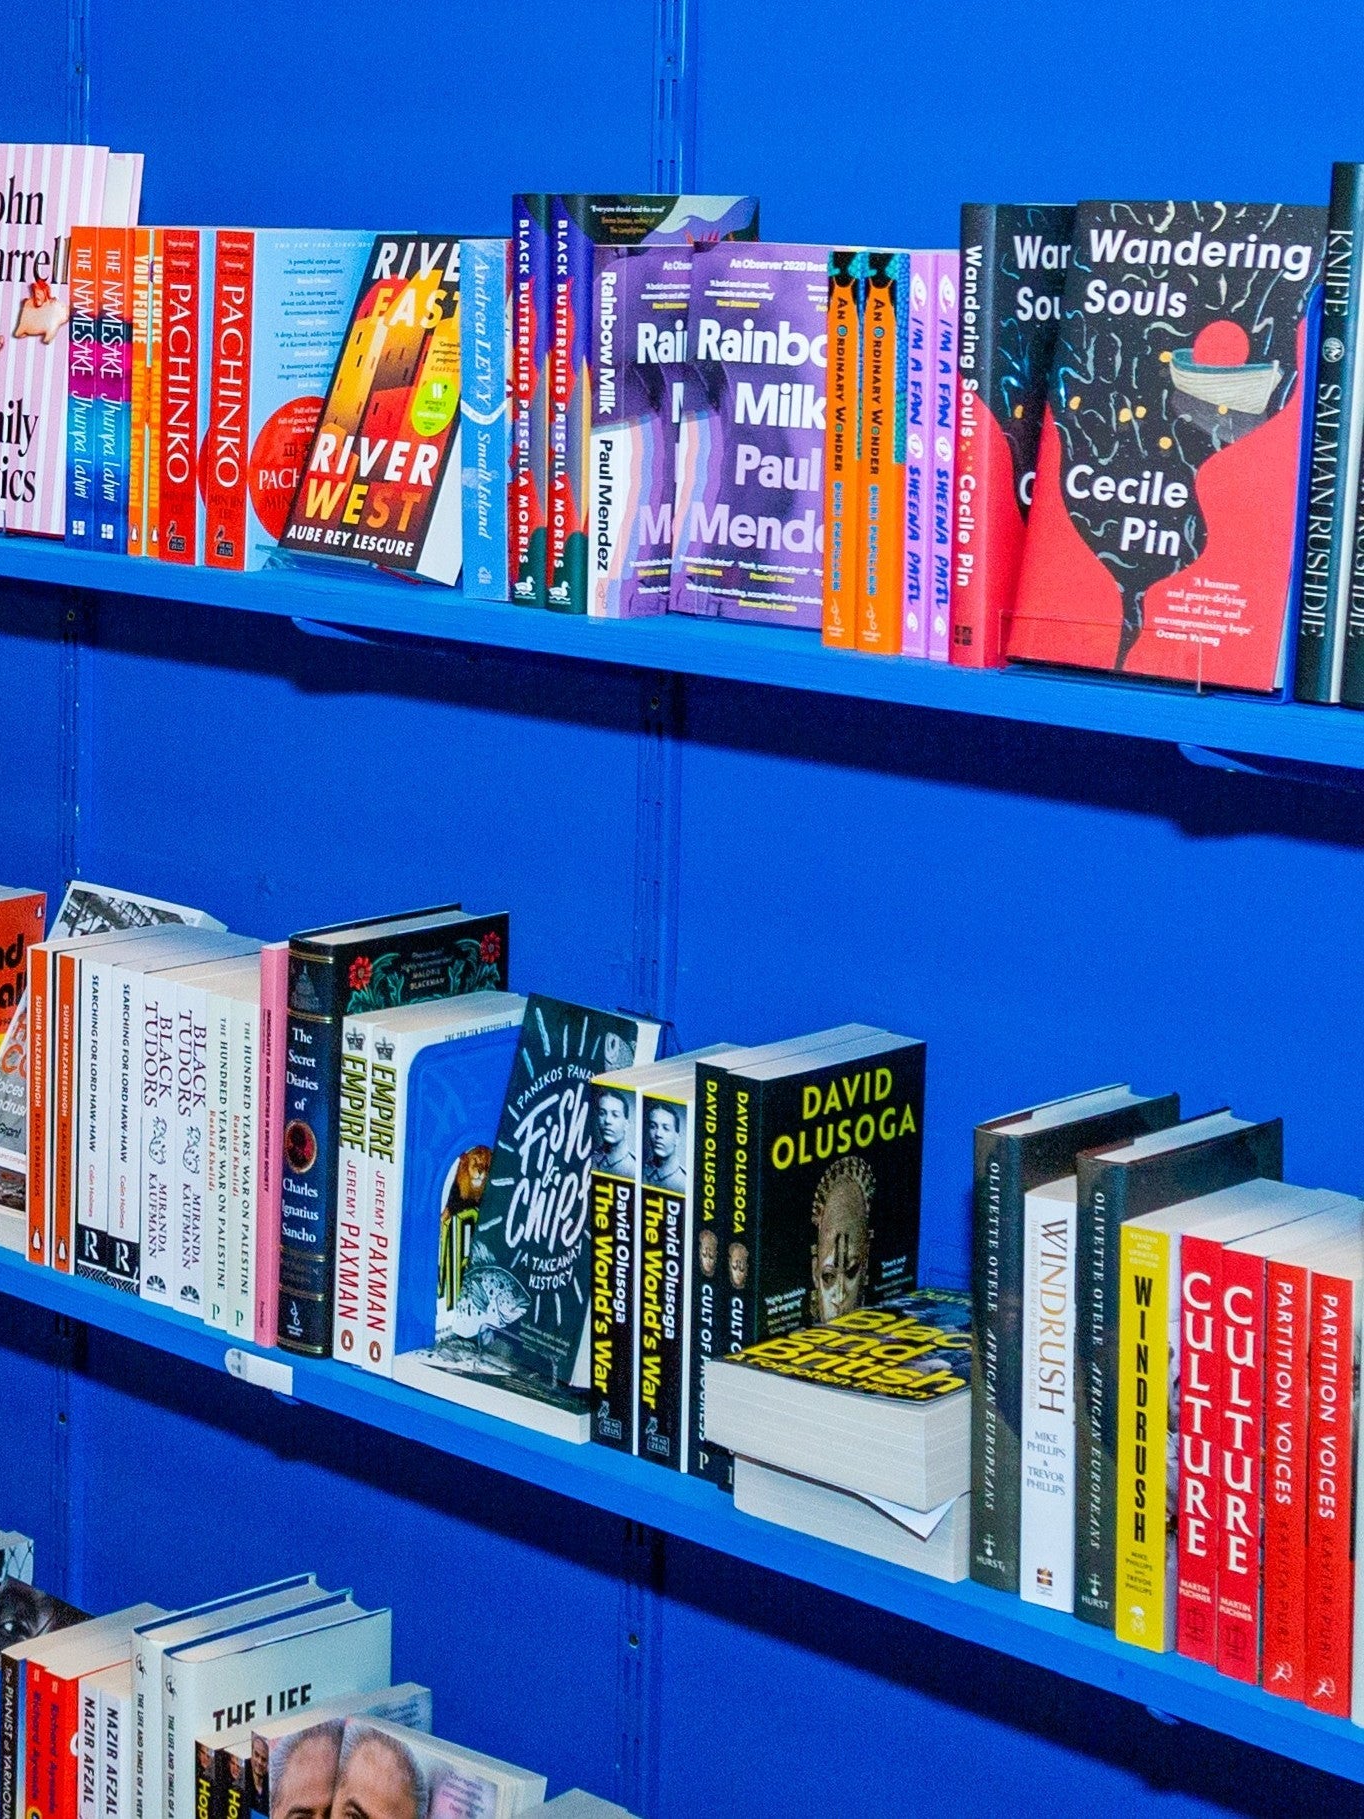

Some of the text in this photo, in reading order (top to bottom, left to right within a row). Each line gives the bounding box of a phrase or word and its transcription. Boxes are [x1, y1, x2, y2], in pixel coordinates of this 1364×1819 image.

[372, 242, 460, 281] RIVE
[1089, 230, 1312, 280] Wandering
[1324, 229, 1353, 317] KNIFE
[71, 248, 94, 376] THE NAMESAKE
[1084, 280, 1187, 318] Souls
[473, 256, 492, 410] Andrea LEVY
[598, 272, 616, 414] Rainbow Milk
[959, 244, 982, 437] Wandering Souls
[168, 284, 190, 483] PACHINKO
[215, 285, 244, 488] PACHINKO
[518, 219, 529, 563] BLACK BUTTERFLIES PRISCILLA MORRIS
[913, 362, 923, 375] A
[735, 382, 826, 429] Milk
[310, 433, 437, 487] RIVER
[477, 431, 491, 539] Small Island
[735, 444, 821, 492] Paul
[1065, 465, 1188, 508] Cecile
[305, 481, 422, 532] WEST
[597, 440, 613, 571] Paul Mendez
[909, 465, 920, 541] SHEENA
[1300, 384, 1340, 638] SALMAN RUSHDIE
[287, 524, 413, 556] AUBE REY LESCURE
[1121, 518, 1180, 556] Pin
[89, 974, 99, 1153] SEARCHING FOR LORD HAW-HAW
[178, 1009, 194, 1118] TUDORS
[287, 1050, 315, 1067] Secret
[292, 1027, 312, 1043] The
[190, 1026, 207, 1108] BLACK
[244, 1042, 253, 1113] HUNDRED
[286, 1072, 319, 1091] Diaries
[803, 1068, 893, 1120] DAVID
[294, 1100, 307, 1110] of
[369, 1065, 397, 1163] EMPIRE
[703, 1081, 717, 1221] DAVID OLUSOGA
[771, 1105, 916, 1170] OLUSOGA
[243, 1168, 251, 1202] WAR
[282, 1176, 319, 1200] Charles
[282, 1200, 319, 1222] Ignatius
[595, 1183, 614, 1230] The
[181, 1183, 191, 1268] KAUFMANN
[191, 1195, 201, 1263] MIRANDA
[242, 1207, 249, 1224] ON
[281, 1222, 316, 1243] Sancho
[988, 1162, 1000, 1311] OLIVETTE OTELE
[240, 1228, 249, 1296] PALESTINE
[367, 1170, 389, 1332] JEREMY PAXMAN
[528, 1270, 574, 1289] HISTORY
[615, 1187, 630, 1323] David Olusoga
[789, 1328, 937, 1366] and
[828, 1310, 972, 1347] Blac
[1039, 1219, 1068, 1415] WINDRUSH
[593, 1342, 608, 1394] War
[741, 1338, 966, 1393] British
[985, 1329, 997, 1511] AFRICAN EUROPEANS
[1134, 1275, 1153, 1543] WINDRUSH
[1184, 1272, 1212, 1557] CULTURE
[1222, 1287, 1252, 1575] CULTURE
[1318, 1294, 1337, 1520] PARTITION VOICES
[1026, 1441, 1066, 1460] PHILLIPS
[1035, 1430, 1059, 1445] MIKE
[1026, 1478, 1065, 1497] PHILLIPS
[1028, 1466, 1065, 1483] TREVOR
[976, 1556, 1002, 1570] HURST
[105, 1708, 118, 1816] NAZIR AFZAL
